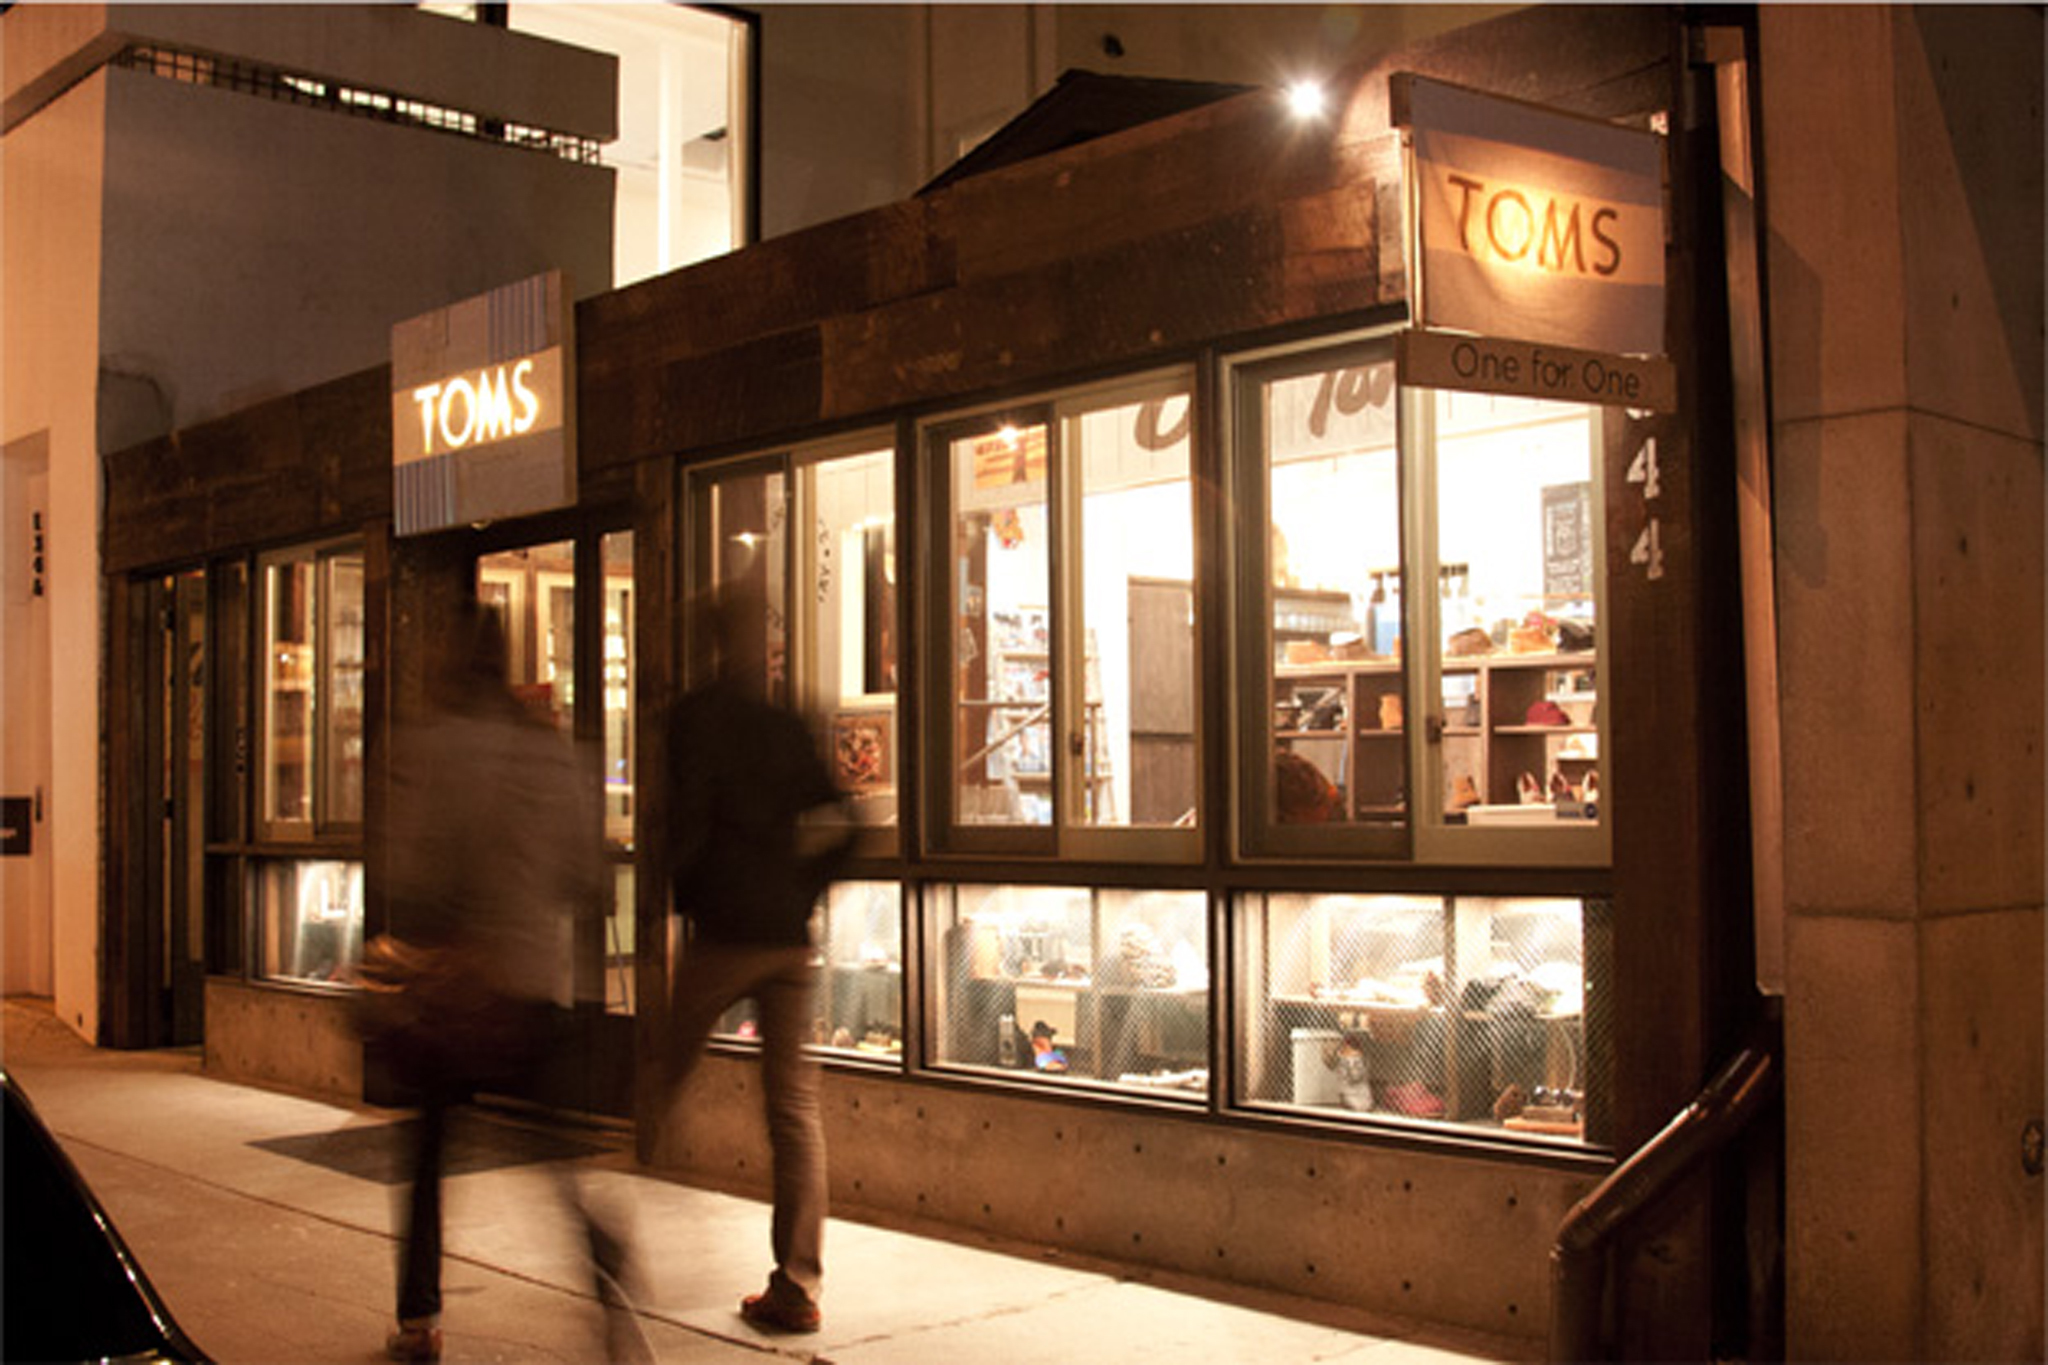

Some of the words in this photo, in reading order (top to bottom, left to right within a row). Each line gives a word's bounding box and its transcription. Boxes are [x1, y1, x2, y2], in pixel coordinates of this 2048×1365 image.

[1447, 173, 1621, 276] TOMS
[413, 359, 539, 454] TOMS
[1452, 342, 1520, 383] One
[1532, 350, 1573, 388] for
[1582, 359, 1640, 398] One
